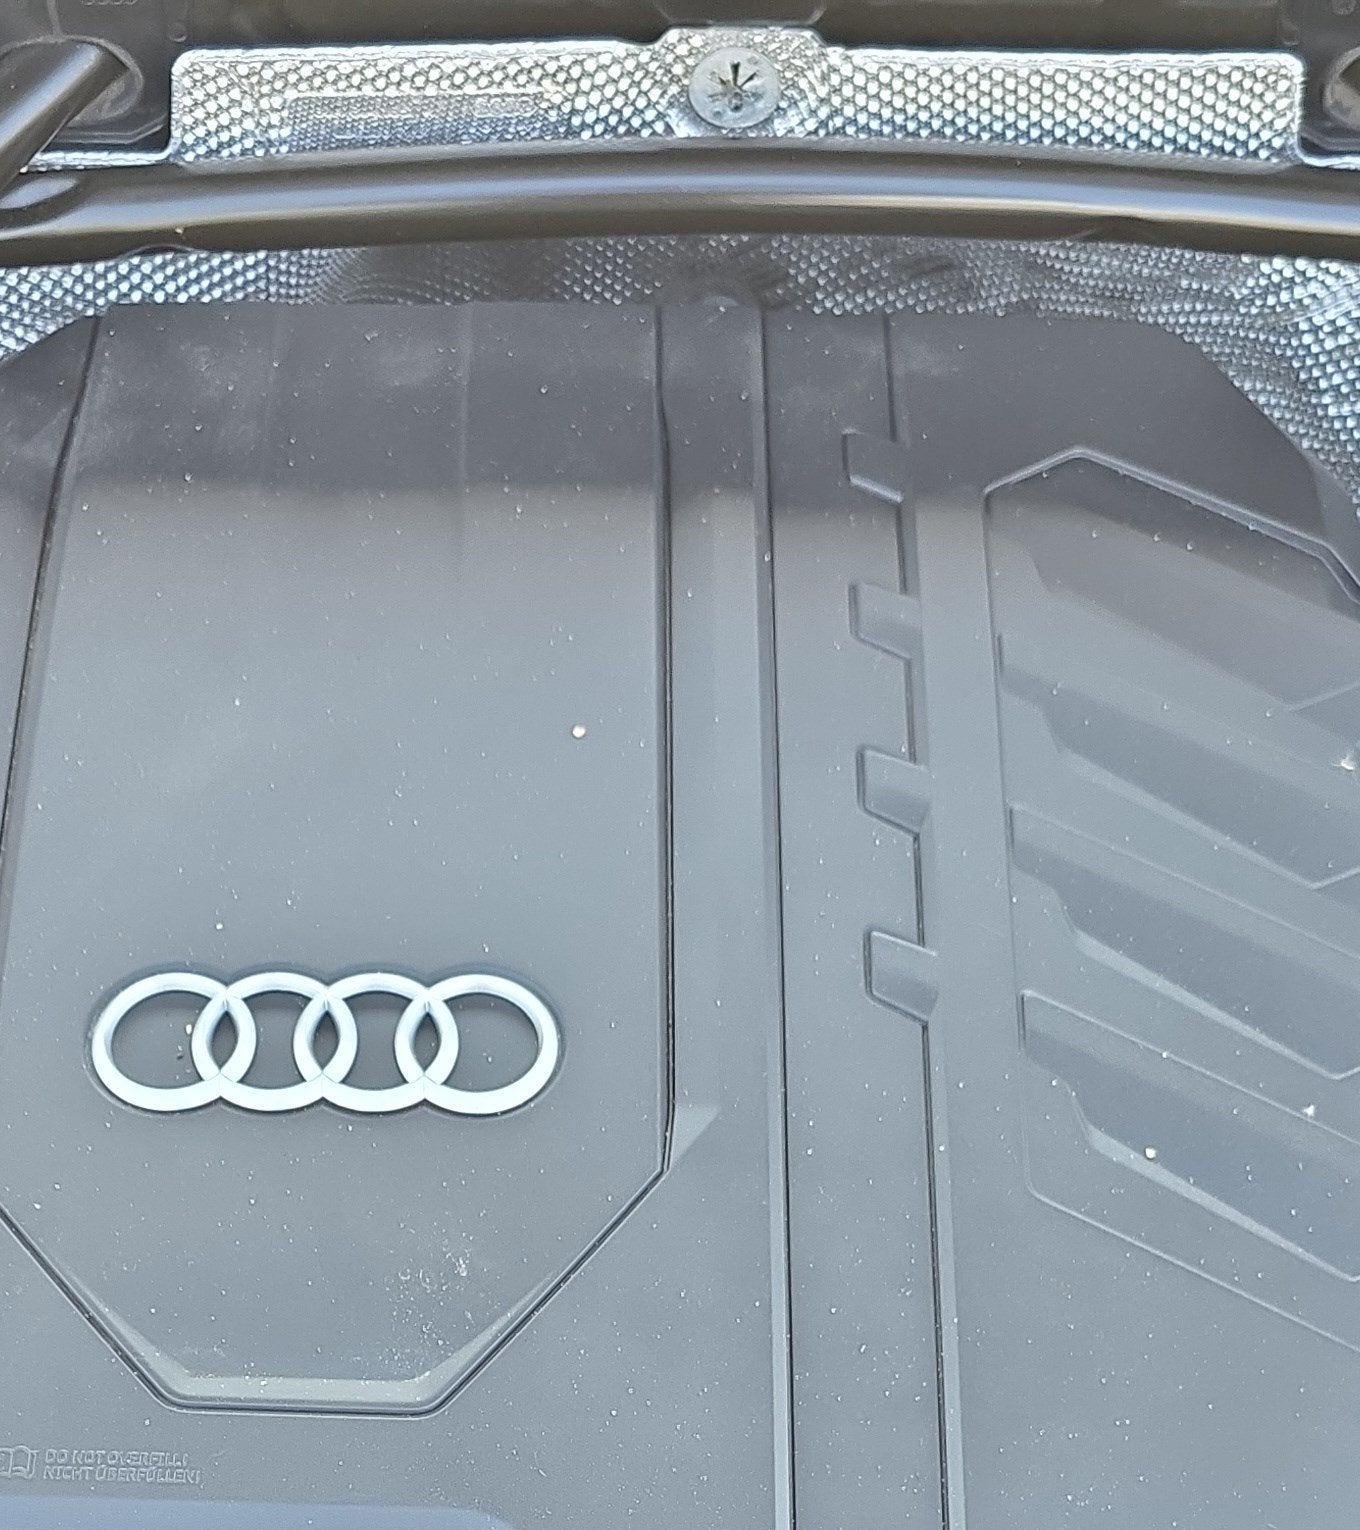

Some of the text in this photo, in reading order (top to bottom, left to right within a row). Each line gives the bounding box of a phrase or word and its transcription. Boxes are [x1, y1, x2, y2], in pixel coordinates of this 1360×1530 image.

[45, 1448, 68, 1463] DO
[72, 1449, 106, 1464] NOT
[43, 1465, 91, 1480] NICHT
